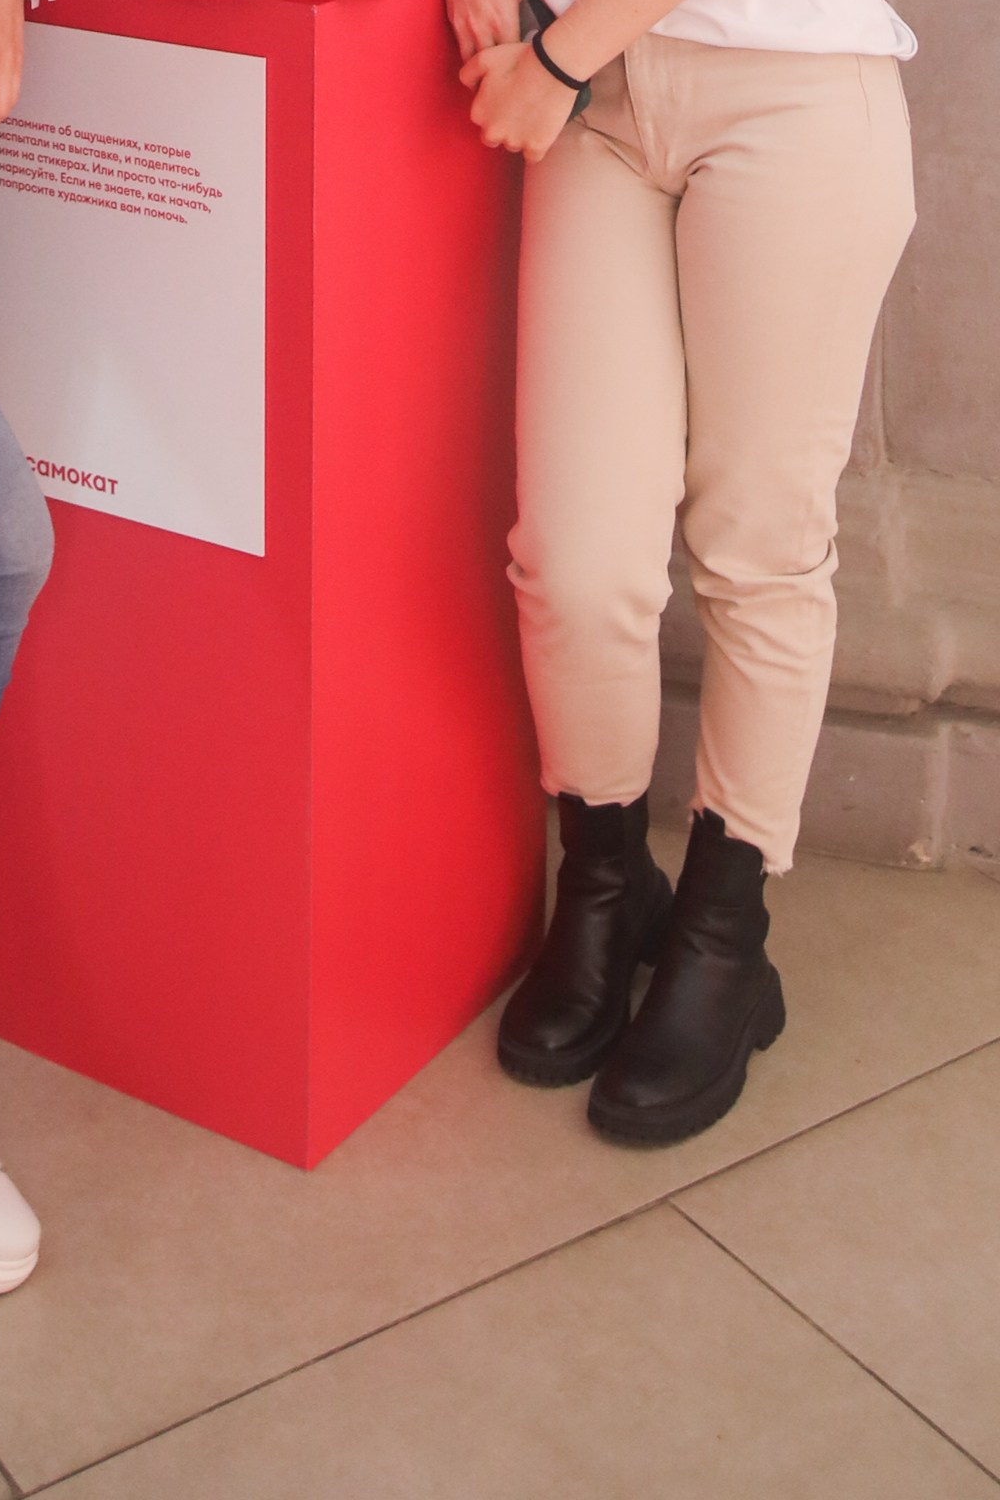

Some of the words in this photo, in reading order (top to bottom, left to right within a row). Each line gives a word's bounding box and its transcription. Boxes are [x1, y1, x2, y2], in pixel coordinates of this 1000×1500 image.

[0, 131, 49, 148] испытали
[52, 141, 66, 152] на
[68, 144, 122, 164] выставке,
[125, 155, 131, 163] и
[134, 157, 200, 177] поделитесь
[58, 125, 72, 137] об
[74, 129, 141, 151] ощущениях,
[144, 143, 191, 159] которые
[0, 147, 19, 158] ими
[22, 151, 35, 161] на
[37, 154, 89, 172] стикерах.
[92, 162, 114, 177] Или
[117, 169, 156, 185] просто
[159, 178, 223, 198] что-нибудь
[0, 162, 58, 182] нарисуйте.
[60, 172, 86, 187] Если
[89, 180, 102, 190] не
[104, 183, 145, 200] знаете,
[147, 192, 166, 203] как
[169, 196, 211, 213] начать,
[0, 177, 55, 196] попросите
[57, 189, 118, 210] художника
[120, 202, 141, 214] вам
[144, 207, 188, 224] помочь.
